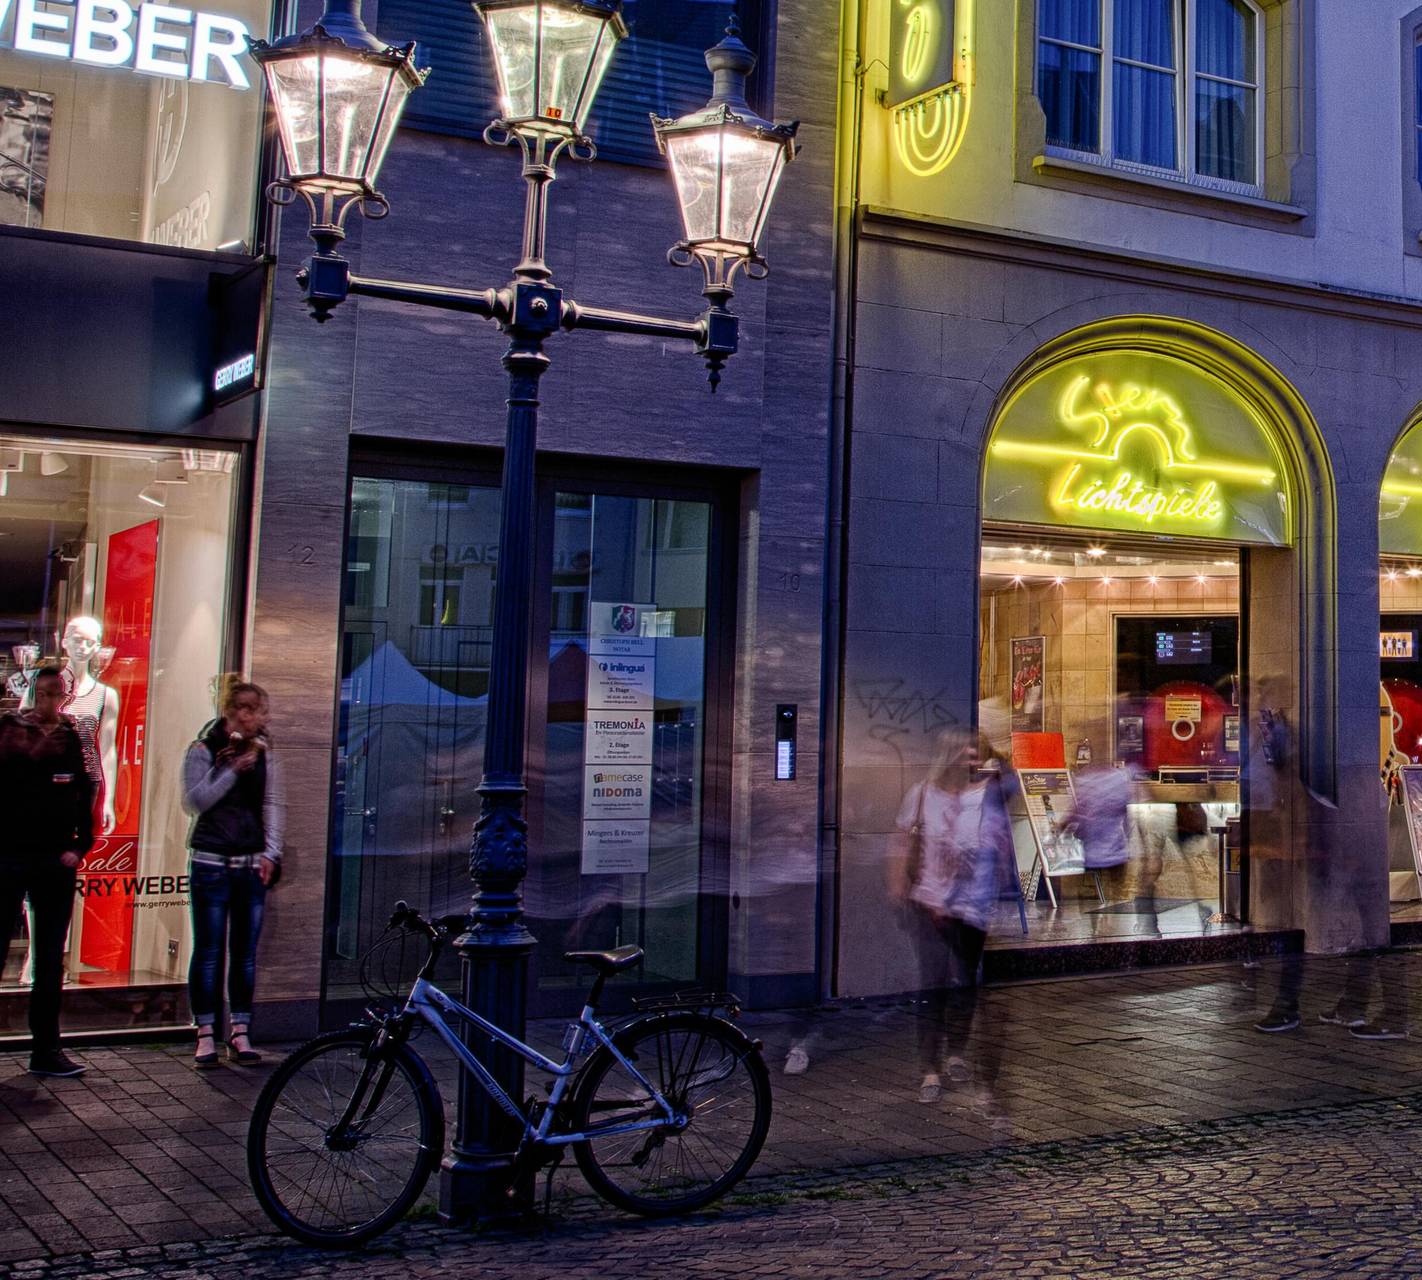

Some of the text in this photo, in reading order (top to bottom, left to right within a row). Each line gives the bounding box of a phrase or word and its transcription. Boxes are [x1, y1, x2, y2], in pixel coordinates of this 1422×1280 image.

[0, 0, 250, 90] EBER
[1055, 463, 1223, 522] Lichtspiele
[609, 662, 646, 674] inlingua
[123, 875, 191, 897] WEBE
